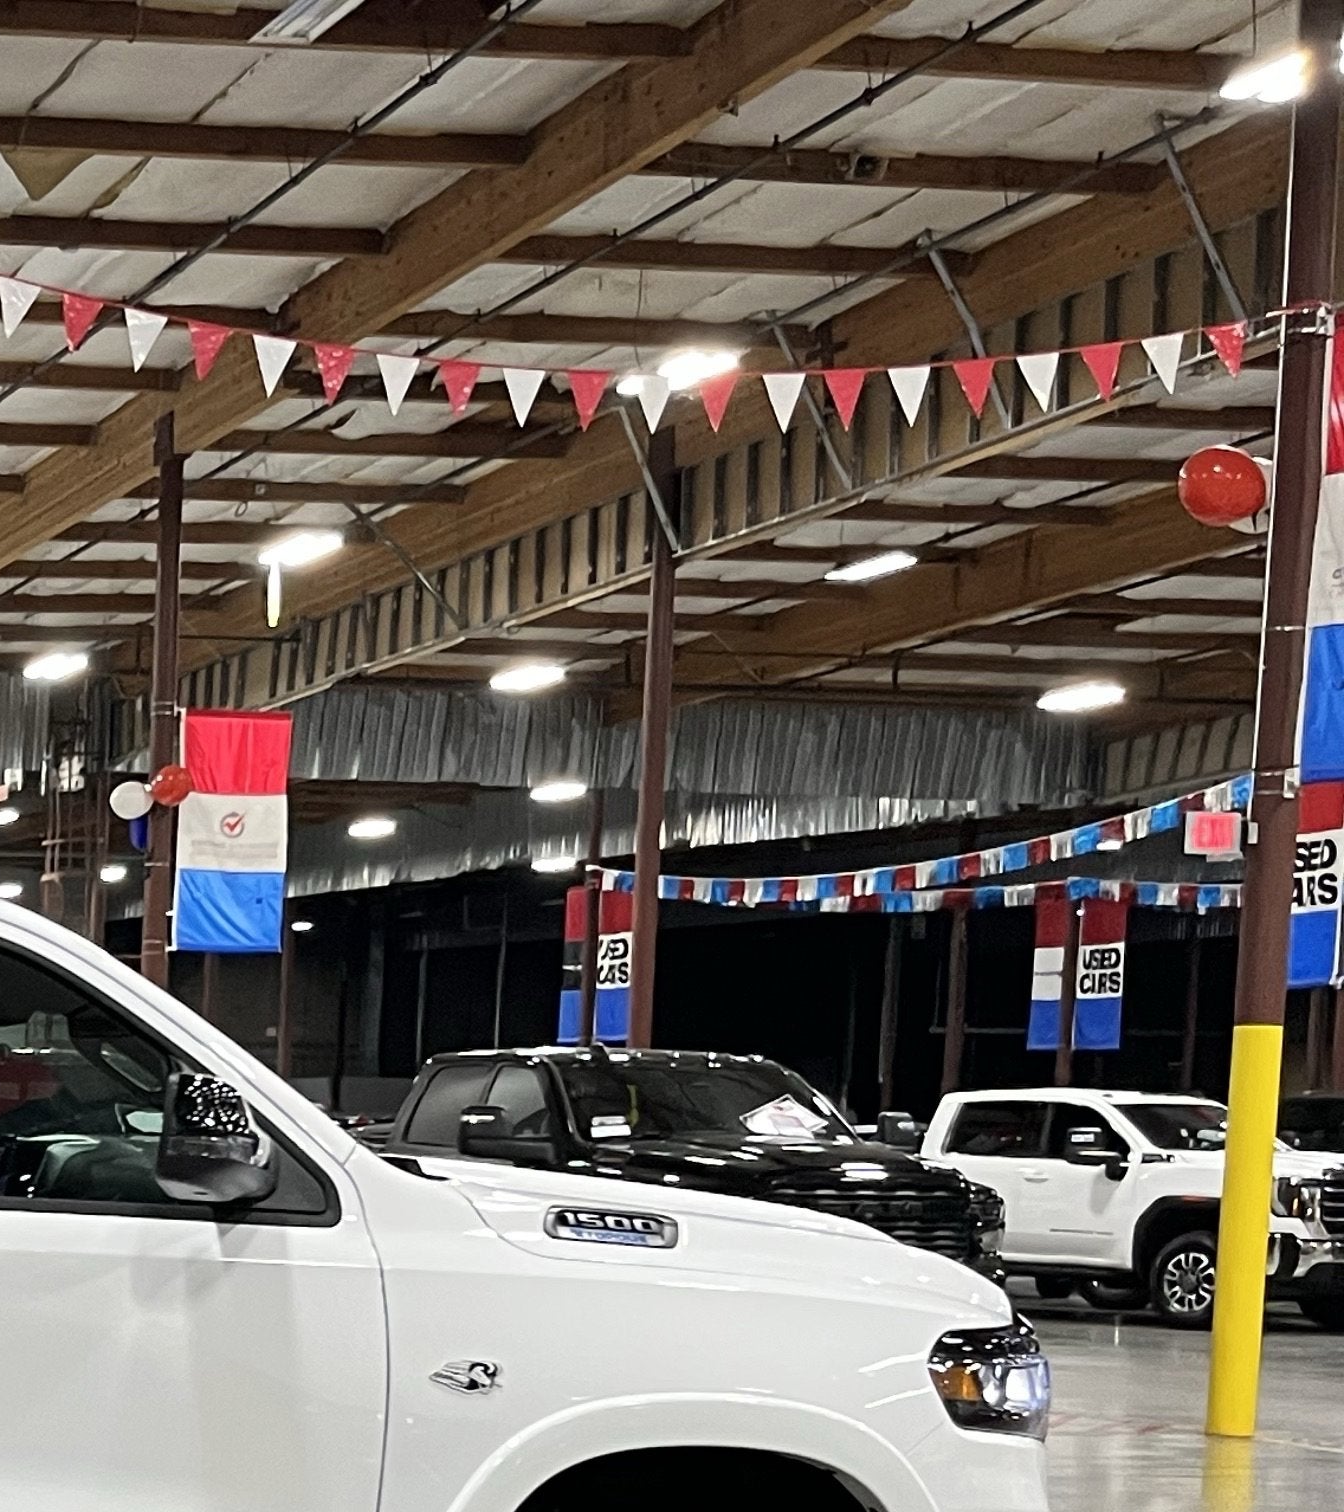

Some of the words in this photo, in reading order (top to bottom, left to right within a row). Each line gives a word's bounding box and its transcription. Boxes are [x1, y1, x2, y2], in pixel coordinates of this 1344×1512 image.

[1295, 838, 1338, 872] SED
[1292, 872, 1339, 907] ARS
[1082, 947, 1121, 970] USED
[562, 1211, 662, 1233] 1500
